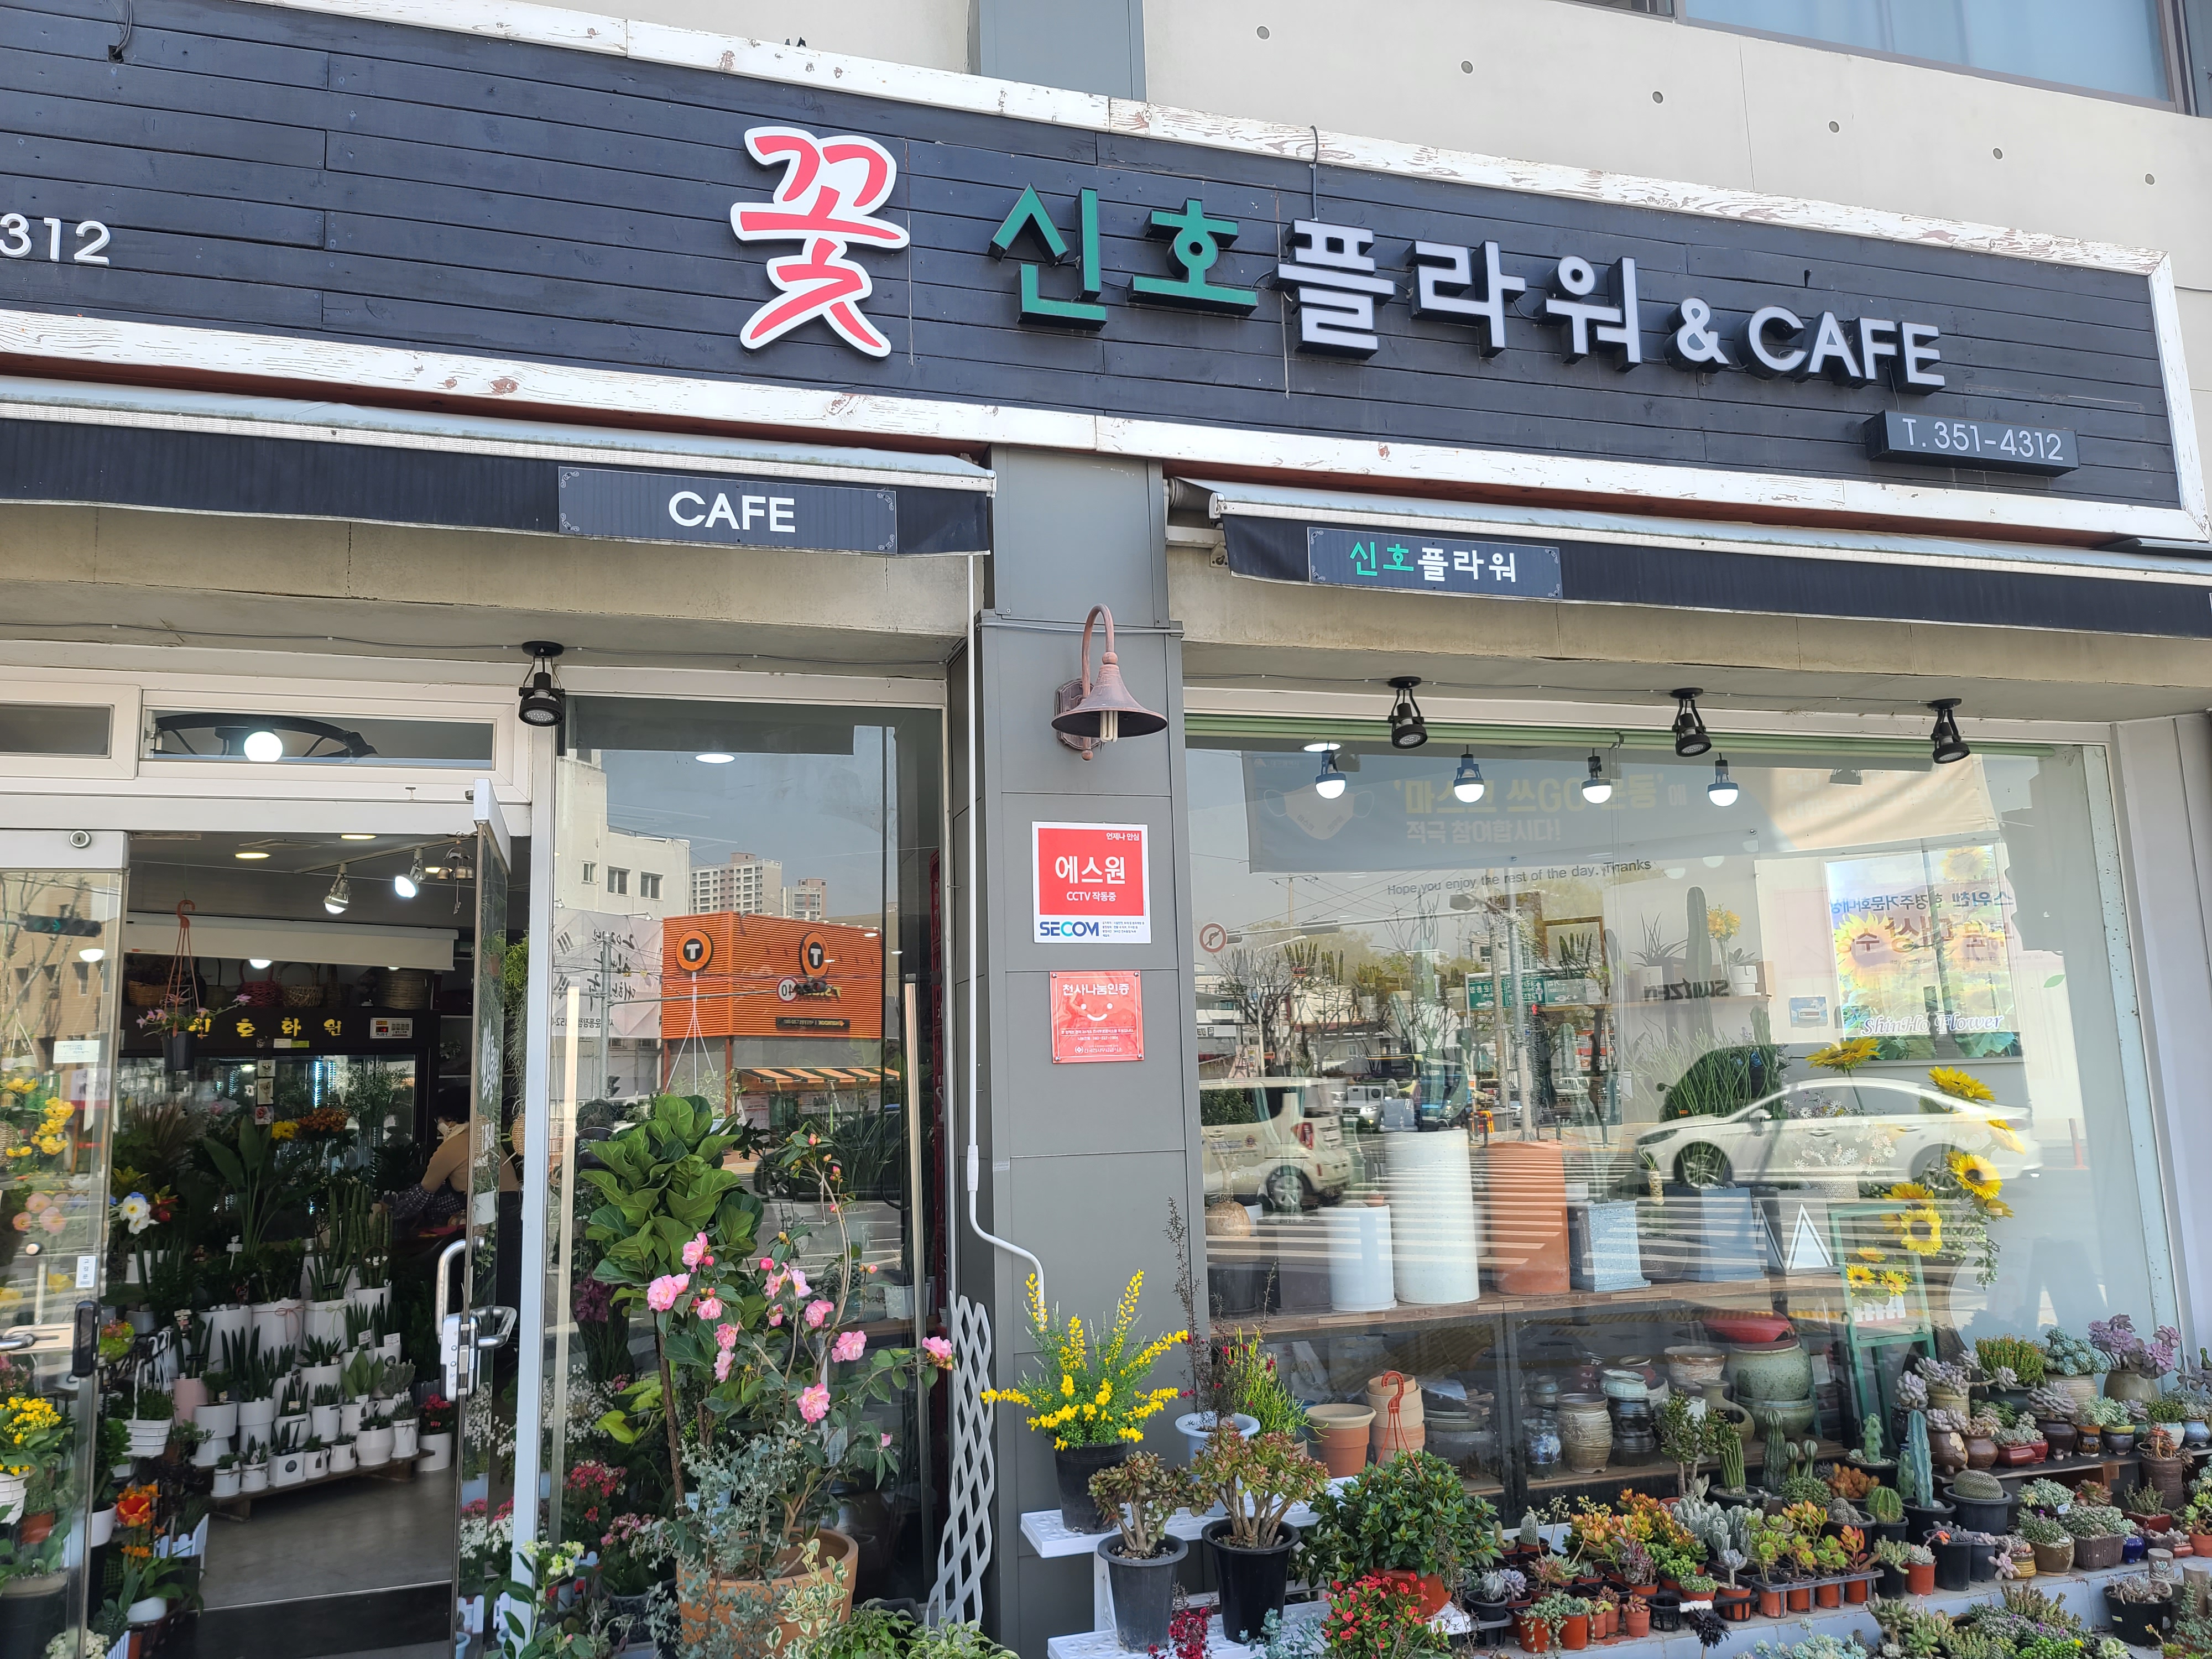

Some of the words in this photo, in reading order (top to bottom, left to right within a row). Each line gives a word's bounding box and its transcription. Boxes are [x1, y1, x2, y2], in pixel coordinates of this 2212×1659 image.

[0, 213, 111, 265] 312
[731, 126, 910, 358] 꽃
[1671, 298, 1730, 371] &
[1741, 305, 1946, 392] CAFE
[668, 491, 796, 533] CAFE
[1106, 832, 1126, 841] 언제나
[1126, 832, 1140, 841] 안심
[1055, 855, 1125, 884] 에스원
[1387, 885, 1417, 896] Hope
[1421, 883, 1442, 893] you
[1445, 877, 1477, 890] enjoy
[1481, 873, 1500, 885] the
[1504, 871, 1527, 884] rest
[1531, 869, 1543, 881] of
[1547, 867, 1567, 880] the
[1604, 858, 1652, 875] Thanks
[1066, 891, 1091, 901] CCTV
[1092, 891, 1117, 902] 작동중
[1040, 921, 1099, 937] SECOM
[1062, 983, 1130, 996] 천사나눔인증
